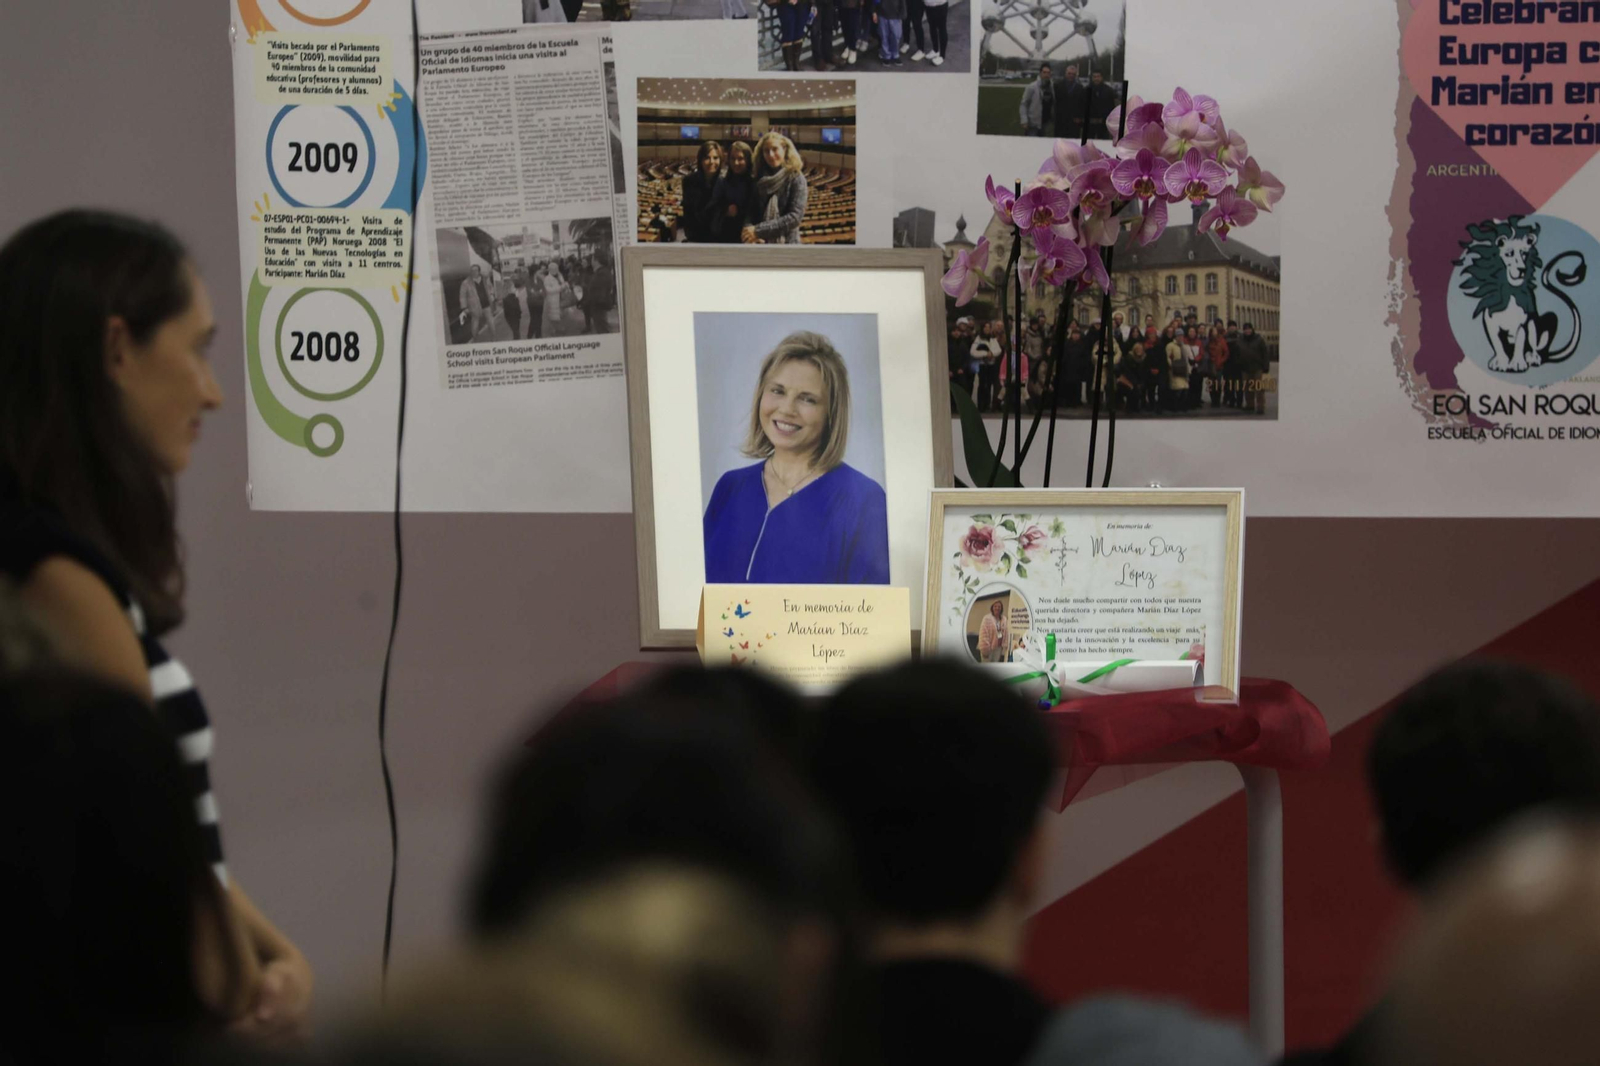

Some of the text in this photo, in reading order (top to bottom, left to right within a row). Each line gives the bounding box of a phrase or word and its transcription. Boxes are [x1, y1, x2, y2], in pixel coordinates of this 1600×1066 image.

[1439, 0, 1600, 25] Celebran
[290, 41, 314, 50] becada
[316, 44, 328, 52] por
[330, 41, 337, 50] el
[338, 42, 380, 52] Parlamento
[434, 48, 459, 58] grupo
[472, 45, 483, 53] 40
[484, 43, 525, 52] miembros
[527, 41, 537, 50] de
[539, 41, 546, 49] la
[548, 39, 579, 48] Escuela
[328, 53, 362, 62] movilidad
[364, 56, 380, 64] para
[421, 49, 567, 66] Oficial de Idiomas inicia una visita al
[1439, 35, 1567, 73] Europa
[282, 63, 316, 72] miembros
[318, 63, 326, 72] de
[328, 63, 335, 72] la
[337, 64, 376, 73] comunidad
[422, 64, 506, 75] Parlamento Europeo
[266, 74, 382, 85] educativa (profesores y alumnos)
[279, 85, 369, 95] de una duración de 5 días.
[1431, 74, 1600, 106] Marián en
[1465, 114, 1600, 146] corazó
[288, 142, 358, 173] 2009
[362, 216, 382, 225] Visita
[394, 217, 403, 225] de
[264, 225, 403, 237] estudio del Programa de Aprendizaje
[264, 235, 301, 244] Permanente
[307, 236, 327, 246] (PAP)
[332, 237, 362, 248] Noruega
[368, 237, 387, 246] 2008
[264, 247, 276, 255] Uso
[281, 247, 289, 256] de
[296, 247, 305, 256] las
[313, 247, 337, 256] Nuevas
[344, 248, 386, 259] Tecnologías
[322, 258, 342, 267] visita
[359, 259, 367, 268] 11
[373, 260, 403, 268] centros.
[265, 268, 345, 279] Participante: Marián Díaz
[290, 331, 360, 362] 2008
[446, 341, 600, 359] Group from San Roque Official Language
[447, 353, 575, 368] School visits European Parliament
[1433, 394, 1471, 416] EOI
[1479, 394, 1526, 416] SAN
[1427, 426, 1600, 440] ESCUELA OFICIAL DE IDIO
[1114, 562, 1157, 589] López
[783, 598, 874, 613] En memoria de
[1096, 597, 1128, 606] compartir
[1035, 607, 1059, 615] querida
[1099, 607, 1135, 615] compañera
[1137, 606, 1161, 614] Marián
[1163, 606, 1179, 614] Díaz
[1181, 606, 1201, 615] López
[1056, 616, 1079, 625] dejado.
[839, 621, 869, 636] Díaz
[1165, 627, 1181, 636] viaje
[812, 643, 846, 663] López
[1108, 647, 1134, 655] siempre.
